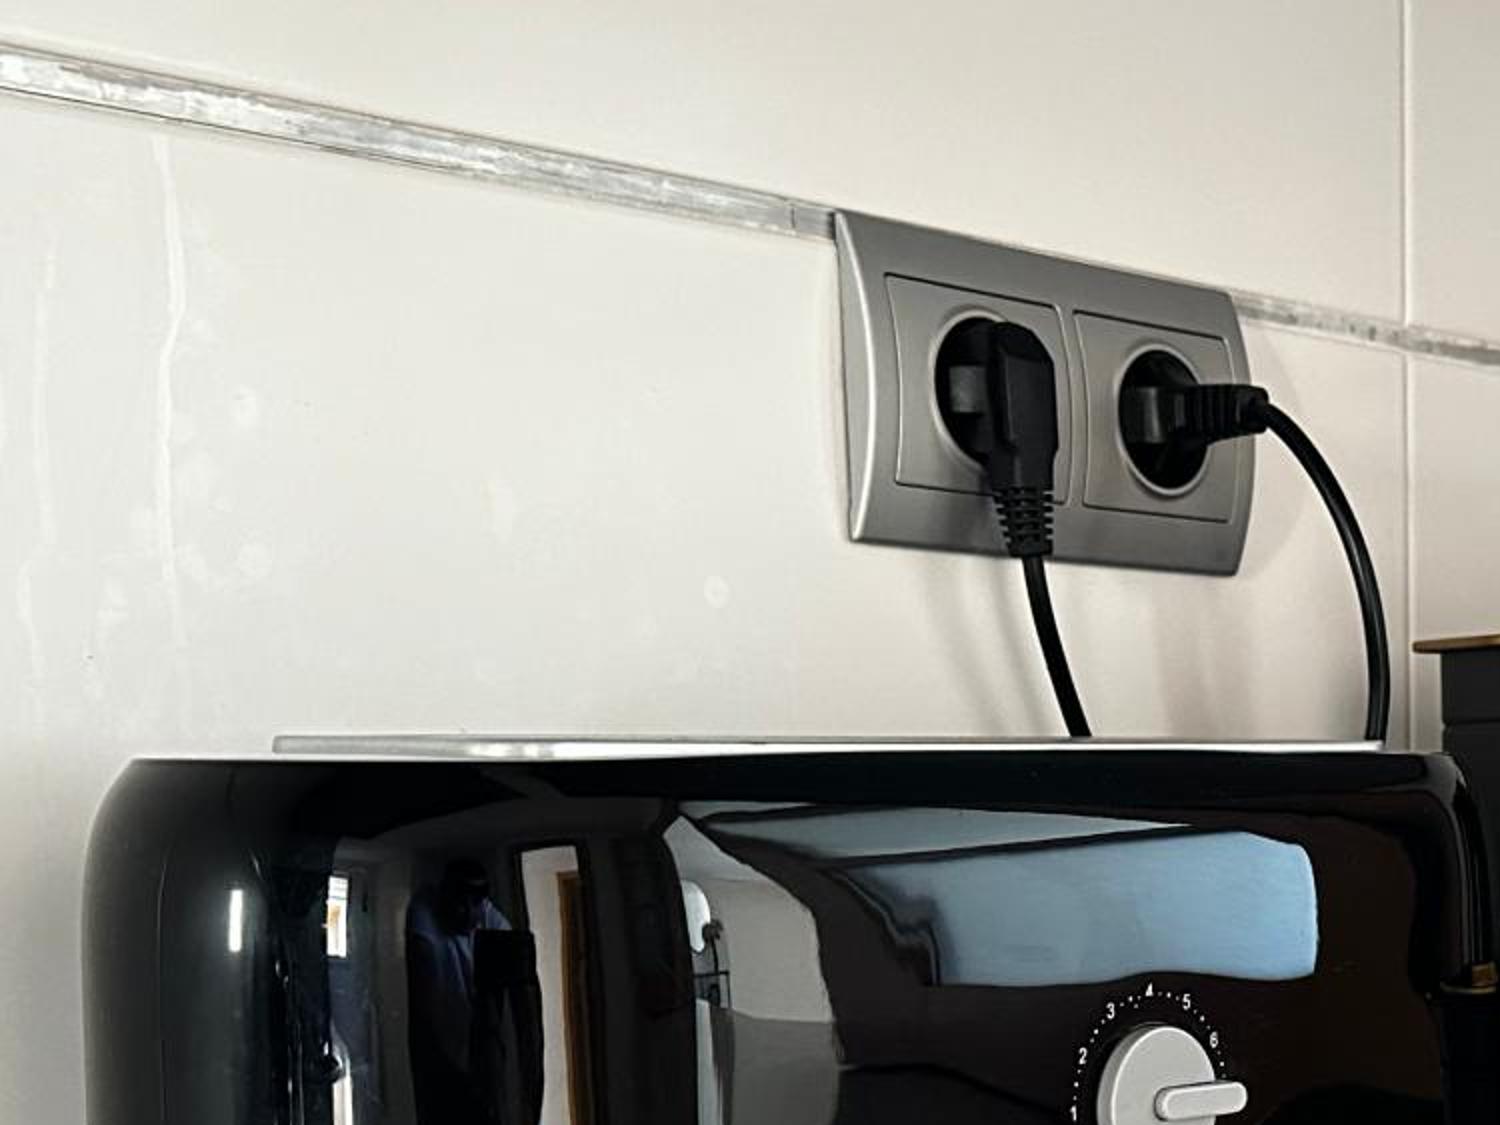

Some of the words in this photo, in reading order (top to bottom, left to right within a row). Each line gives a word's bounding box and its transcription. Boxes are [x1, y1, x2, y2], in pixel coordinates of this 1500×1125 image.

[1070, 1105, 1077, 1121] 1
[1079, 1047, 1087, 1065] 2
[1106, 1002, 1115, 1019] 3
[1145, 982, 1153, 997] 4
[1182, 993, 1191, 1010] 5
[1210, 1031, 1218, 1048] 6
